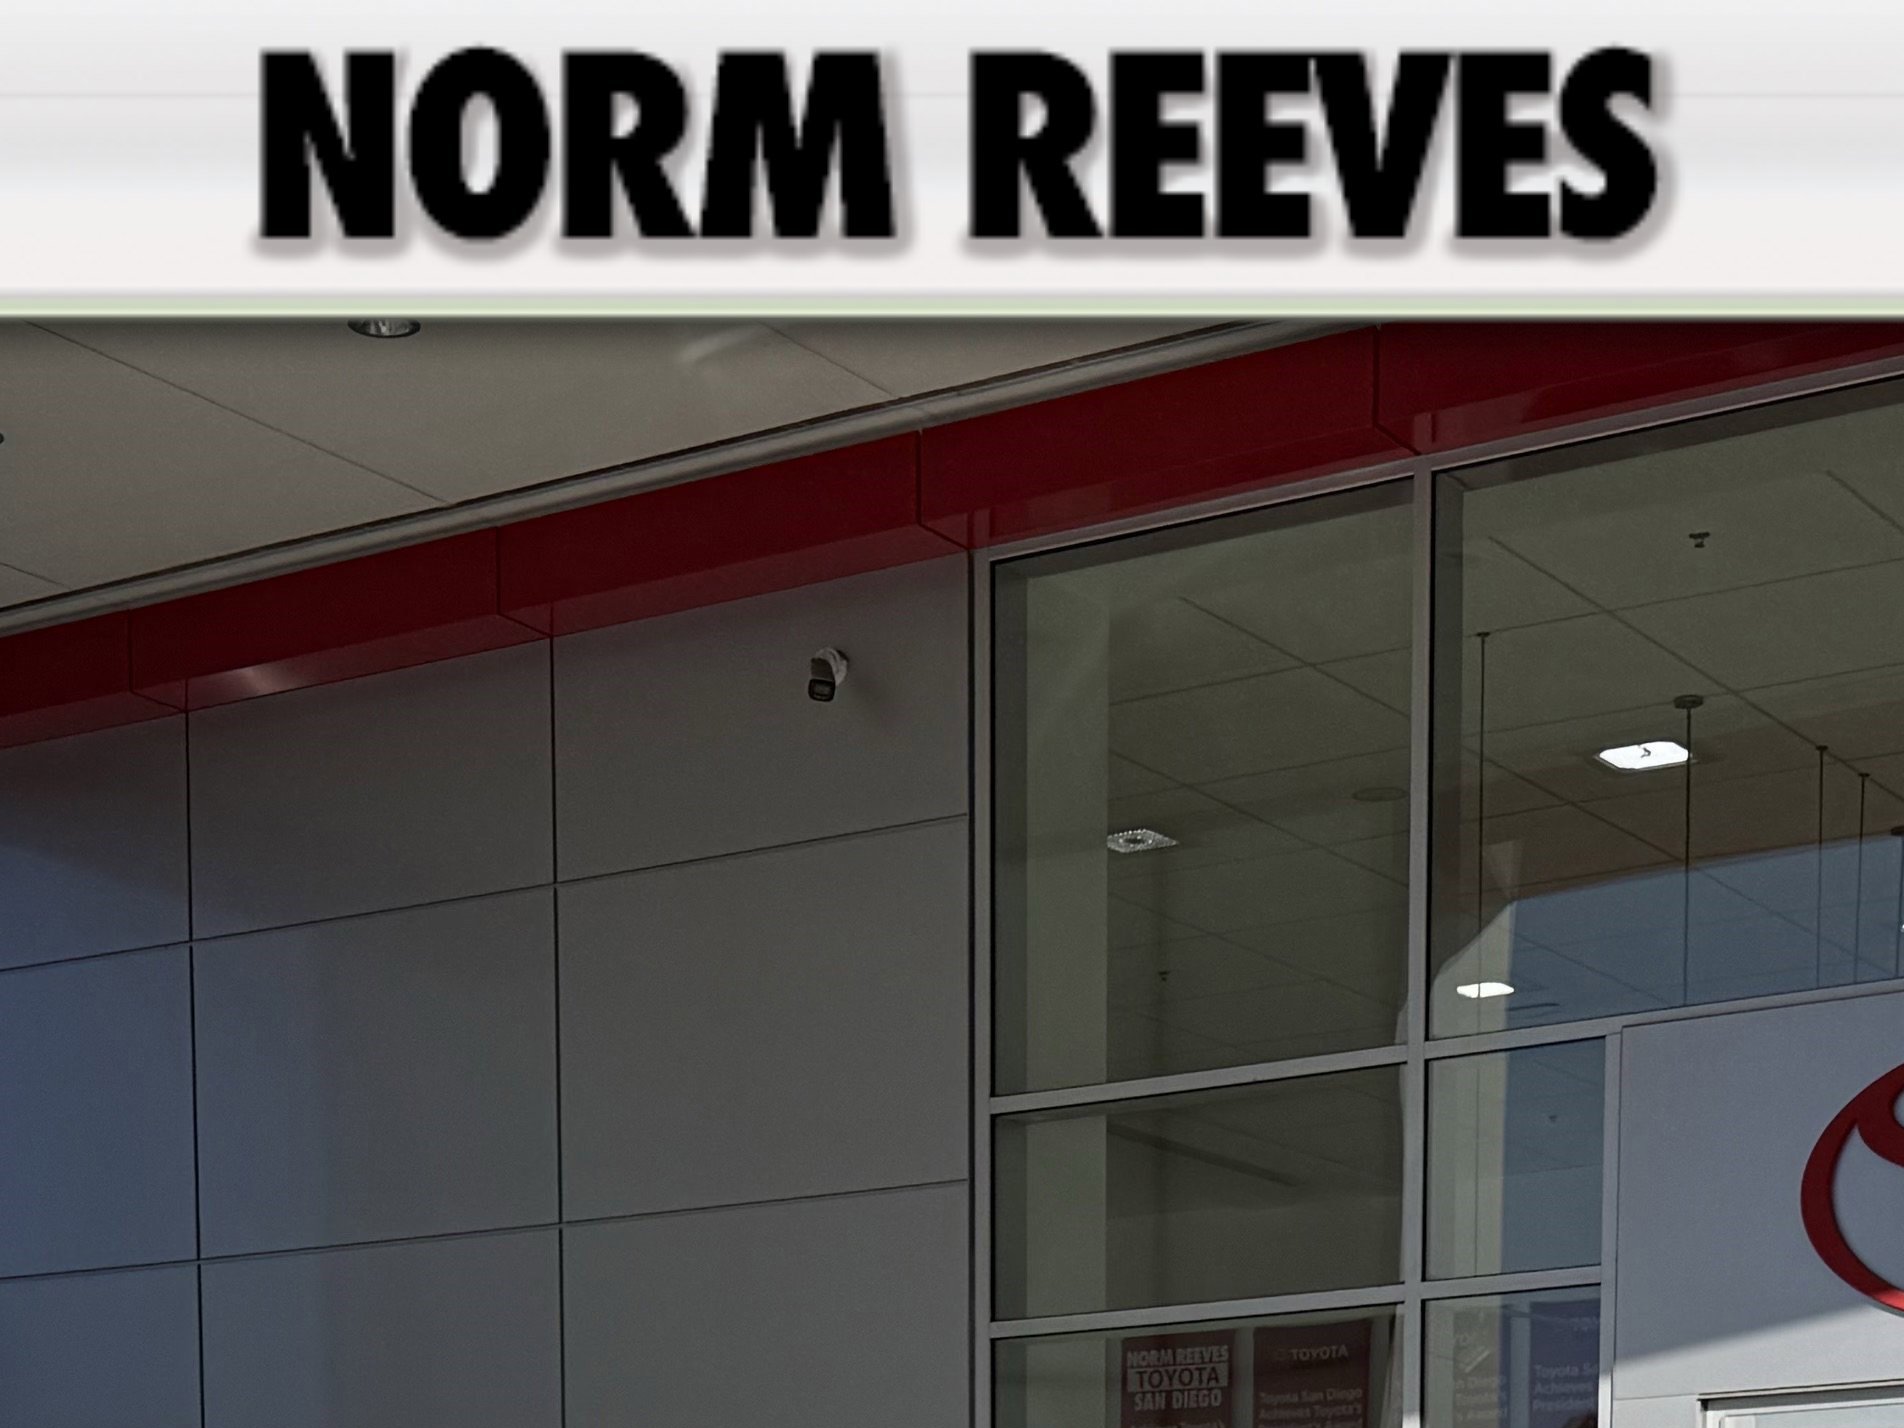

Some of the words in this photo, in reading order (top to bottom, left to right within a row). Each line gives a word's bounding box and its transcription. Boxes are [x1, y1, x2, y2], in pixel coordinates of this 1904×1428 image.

[1127, 1349, 1174, 1367] NORM
[1176, 1345, 1229, 1364] REEVES
[1290, 1344, 1349, 1360] TOYOTA
[1136, 1367, 1220, 1389] TOYOTA
[1134, 1391, 1166, 1411] SAN
[1172, 1389, 1223, 1409] DIEGO
